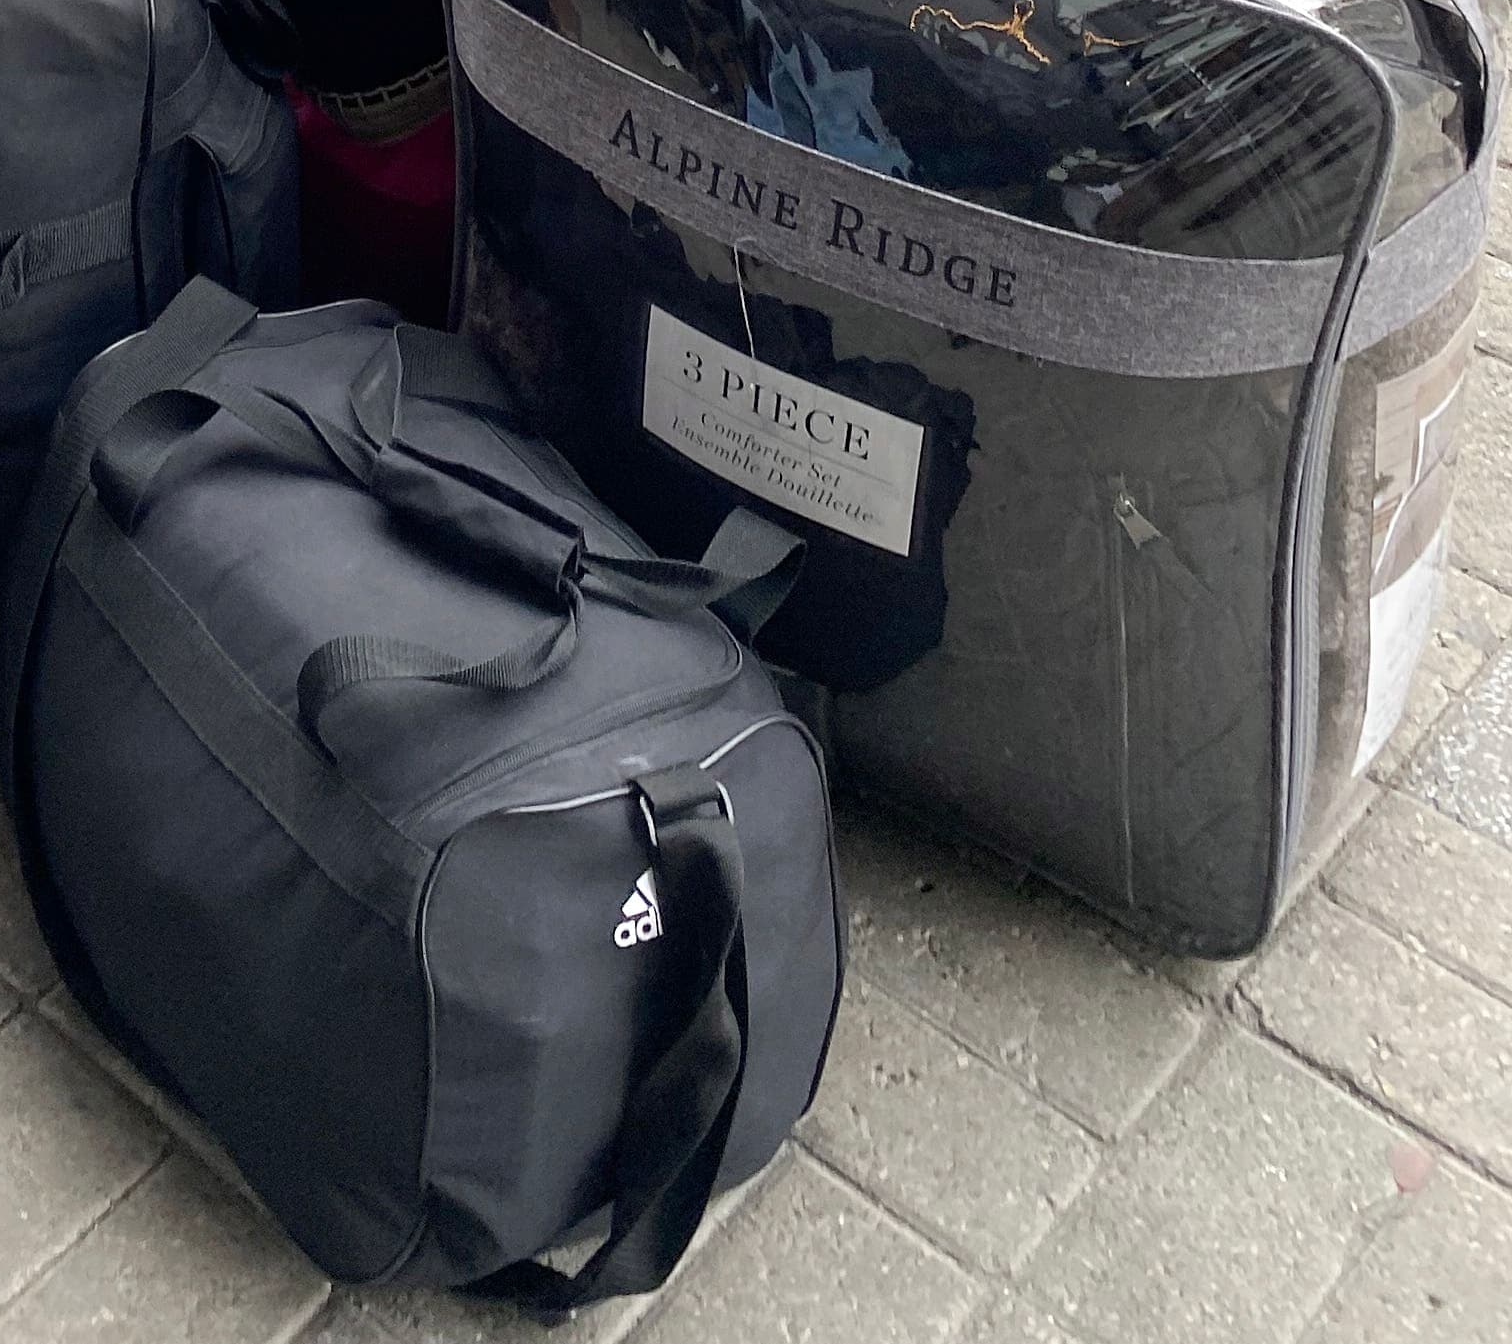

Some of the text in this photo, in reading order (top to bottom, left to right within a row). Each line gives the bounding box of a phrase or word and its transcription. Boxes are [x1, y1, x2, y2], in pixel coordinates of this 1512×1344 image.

[608, 108, 1017, 309] ALPINE RIDGE
[682, 350, 872, 461] 3 PIECE
[700, 412, 842, 488] Comforter Set
[671, 415, 875, 524] Ensemble Douillette
